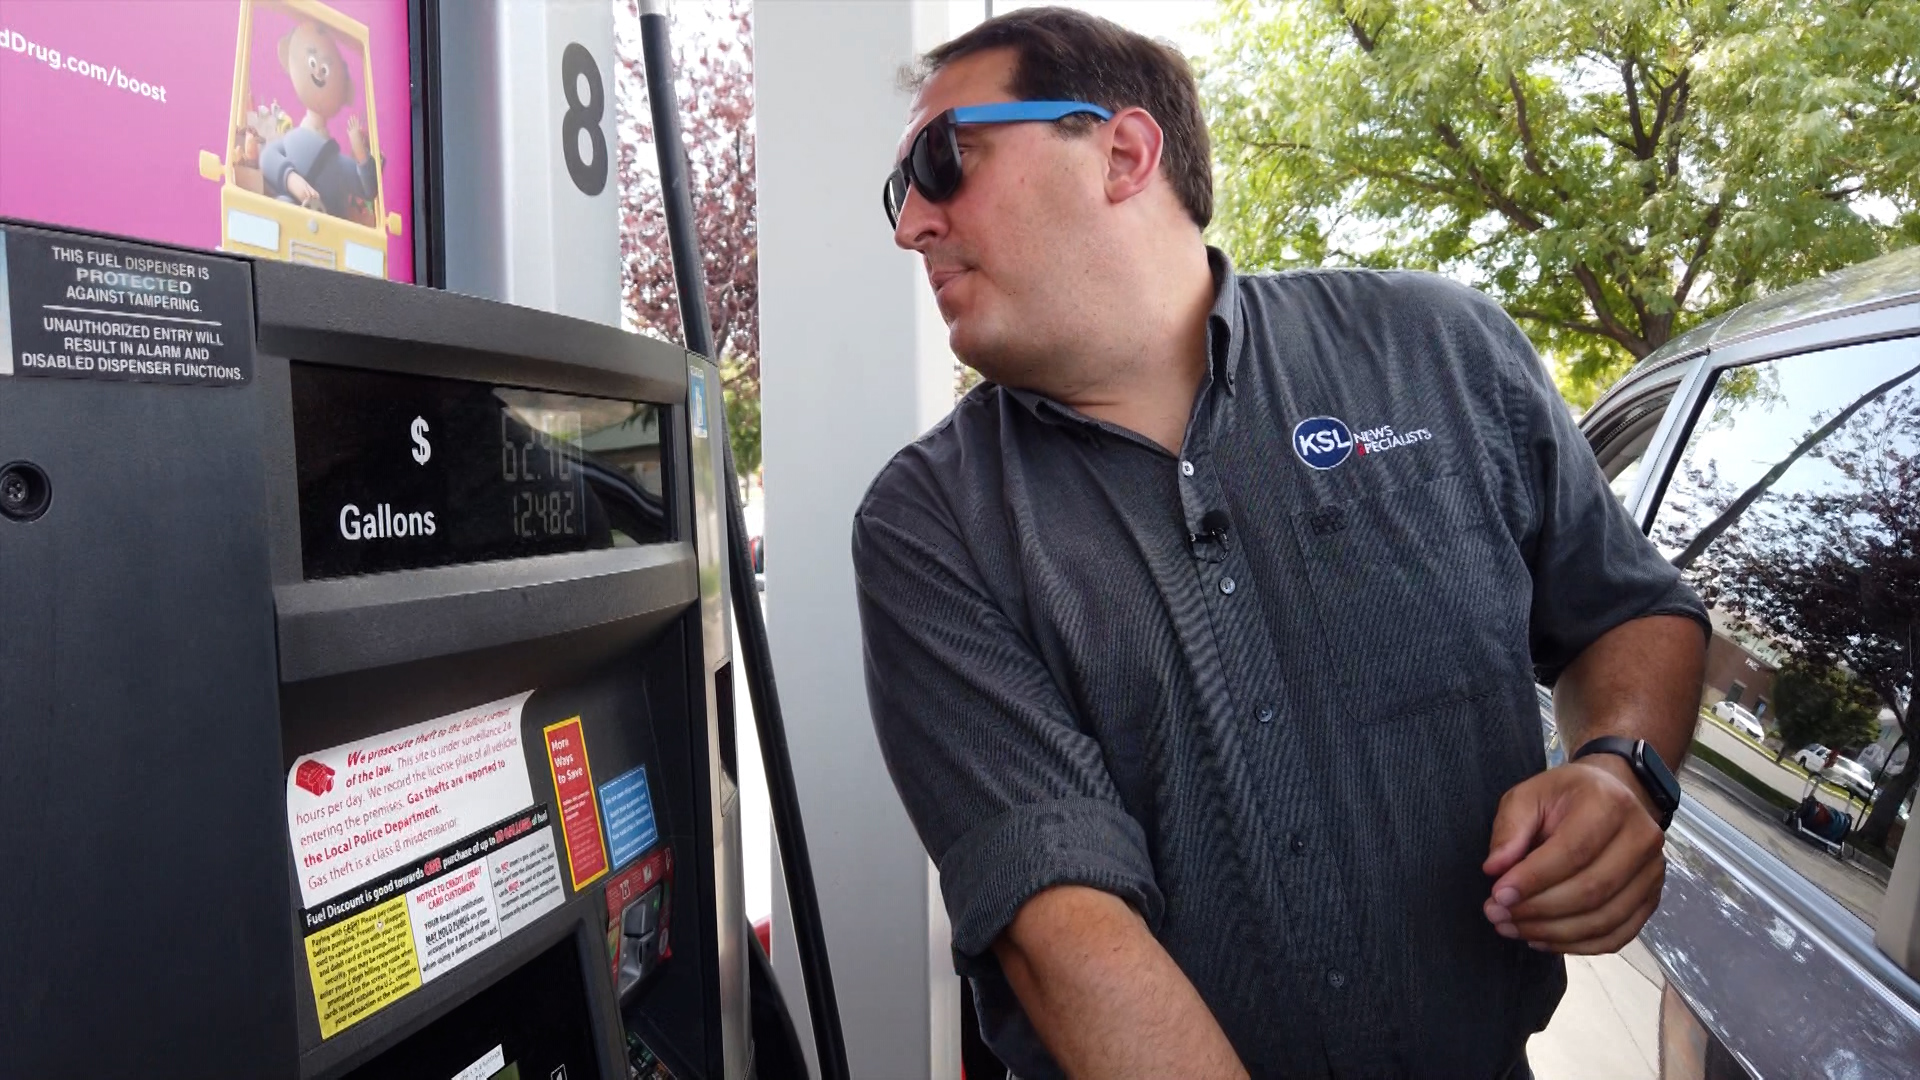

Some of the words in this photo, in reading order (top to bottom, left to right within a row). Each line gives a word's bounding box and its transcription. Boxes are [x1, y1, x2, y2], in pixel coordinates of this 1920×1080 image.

[561, 41, 609, 196] 8
[51, 246, 84, 264] THIS
[87, 251, 121, 268] FUEL
[125, 256, 195, 278] DISPENSER
[198, 266, 210, 280] IS
[76, 267, 191, 294] PROTECTED
[66, 285, 125, 304] AGAINST
[127, 291, 202, 312] TAMPERING.
[43, 317, 150, 339] UNAUTHORIZED
[153, 327, 193, 342] ENTRY
[195, 331, 224, 346] WILL
[64, 336, 117, 354] RESULT
[120, 341, 133, 356] IN
[137, 343, 181, 358] ALARM
[184, 347, 209, 360] AND
[22, 351, 94, 370] DISABLED
[98, 357, 171, 376] DISPENSER
[174, 362, 244, 380] FUNCTIONS.
[410, 415, 431, 466] $
[1299, 429, 1350, 456] KSL
[1353, 425, 1394, 443] NEWS
[339, 503, 436, 541] Gallons
[345, 773, 356, 788] of
[358, 770, 374, 784] the
[375, 763, 394, 778] law.
[397, 757, 413, 769] This
[415, 750, 429, 764] site
[430, 748, 437, 758] is
[438, 739, 460, 756] under
[461, 726, 502, 747] surveillance
[347, 749, 366, 768] We
[367, 738, 414, 763] prosecute
[414, 729, 437, 746] theft
[438, 729, 447, 738] to
[448, 722, 461, 734] the
[551, 738, 569, 752] More
[554, 753, 574, 768] Ways
[295, 807, 325, 826] hours
[327, 800, 343, 817] per
[345, 793, 365, 808] day.
[367, 786, 382, 800] We
[383, 775, 411, 794] record
[412, 771, 427, 782] the
[427, 760, 454, 776] license
[455, 753, 474, 769] plate
[474, 748, 481, 760] of
[483, 744, 492, 758] all
[557, 773, 566, 785] to
[566, 767, 583, 781] Save
[300, 822, 344, 847] entering
[344, 814, 361, 828] the
[407, 790, 424, 804] Gas
[424, 780, 450, 798] thefts
[450, 775, 464, 786] are
[465, 759, 497, 782] reported
[497, 759, 506, 769] to
[303, 852, 323, 868] the
[324, 838, 353, 860] Local
[353, 828, 384, 848] Police
[384, 803, 442, 835] Department.
[306, 908, 326, 927] Fuel
[326, 892, 365, 919] Discount
[364, 889, 372, 903] is
[373, 880, 394, 901] good
[394, 867, 424, 889] towards
[442, 849, 473, 869] purchase
[472, 841, 480, 853] of
[480, 839, 489, 851] up
[488, 836, 495, 846] to
[308, 875, 328, 890] Gas
[329, 861, 354, 880] theft
[355, 858, 363, 870] is
[365, 856, 371, 866] a
[372, 845, 394, 863] class
